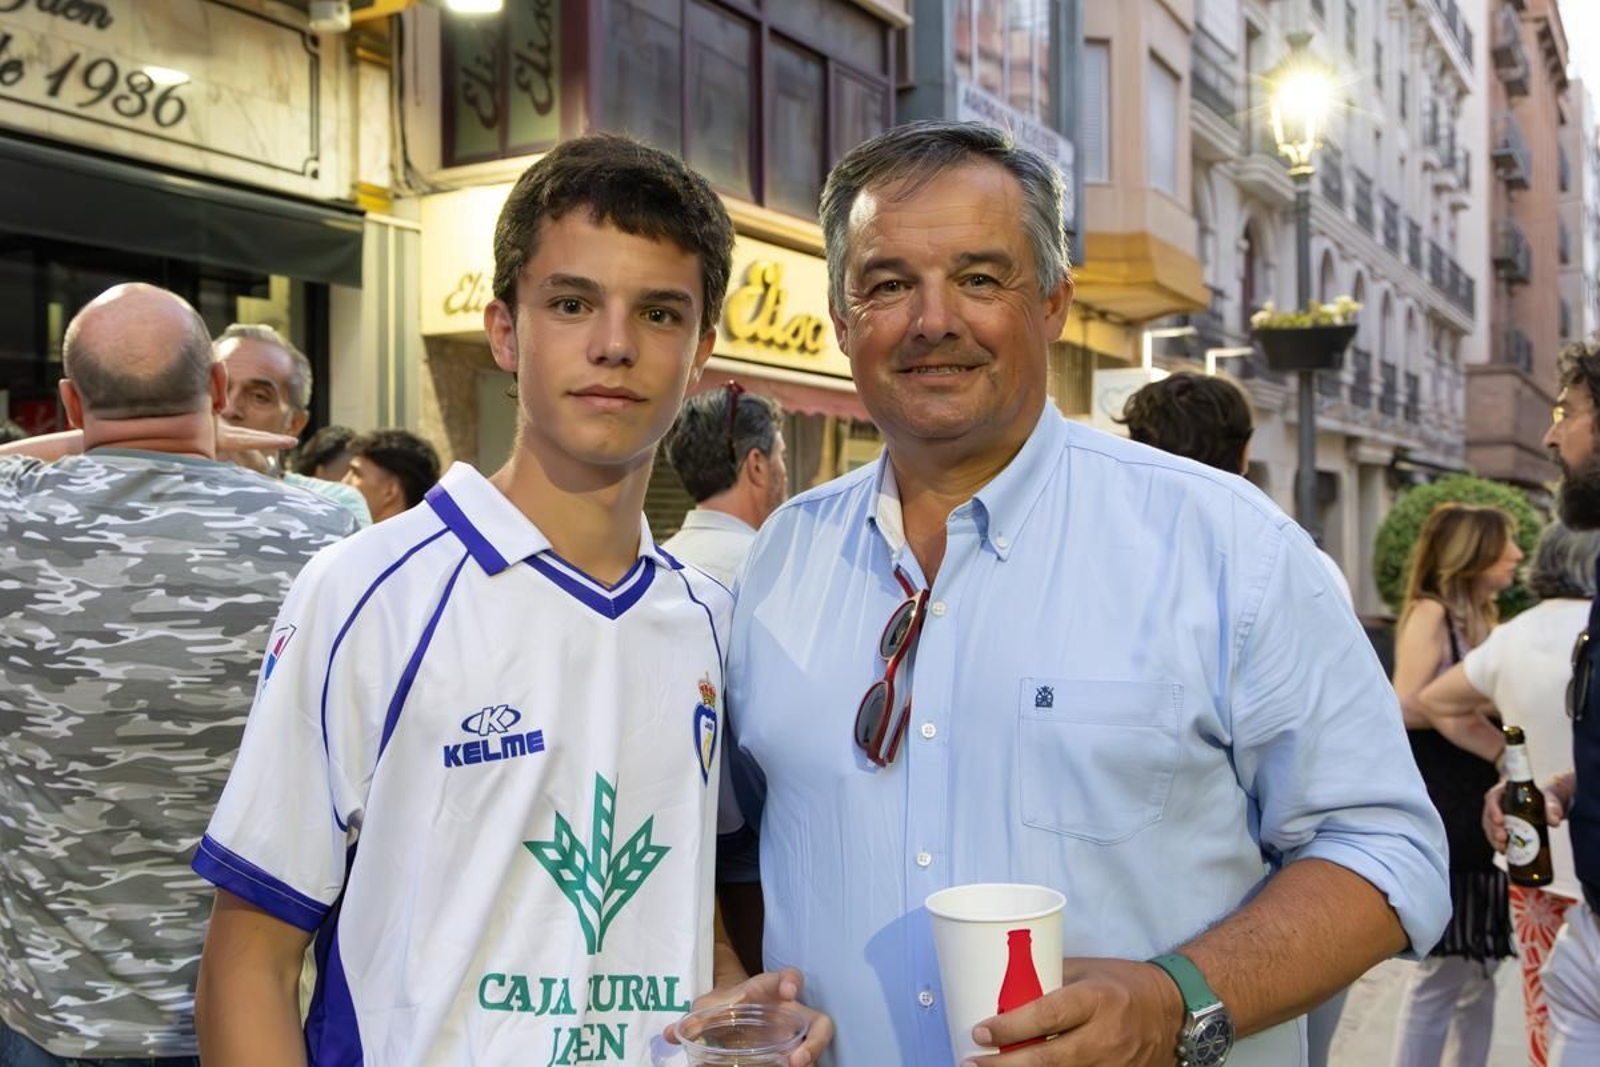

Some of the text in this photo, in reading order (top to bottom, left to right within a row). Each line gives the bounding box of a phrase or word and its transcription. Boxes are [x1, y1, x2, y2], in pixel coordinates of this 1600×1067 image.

[44, 53, 192, 128] 1936
[723, 259, 824, 354] Elisa
[443, 729, 545, 768] KELME
[478, 973, 690, 1016] CAJA URAL
